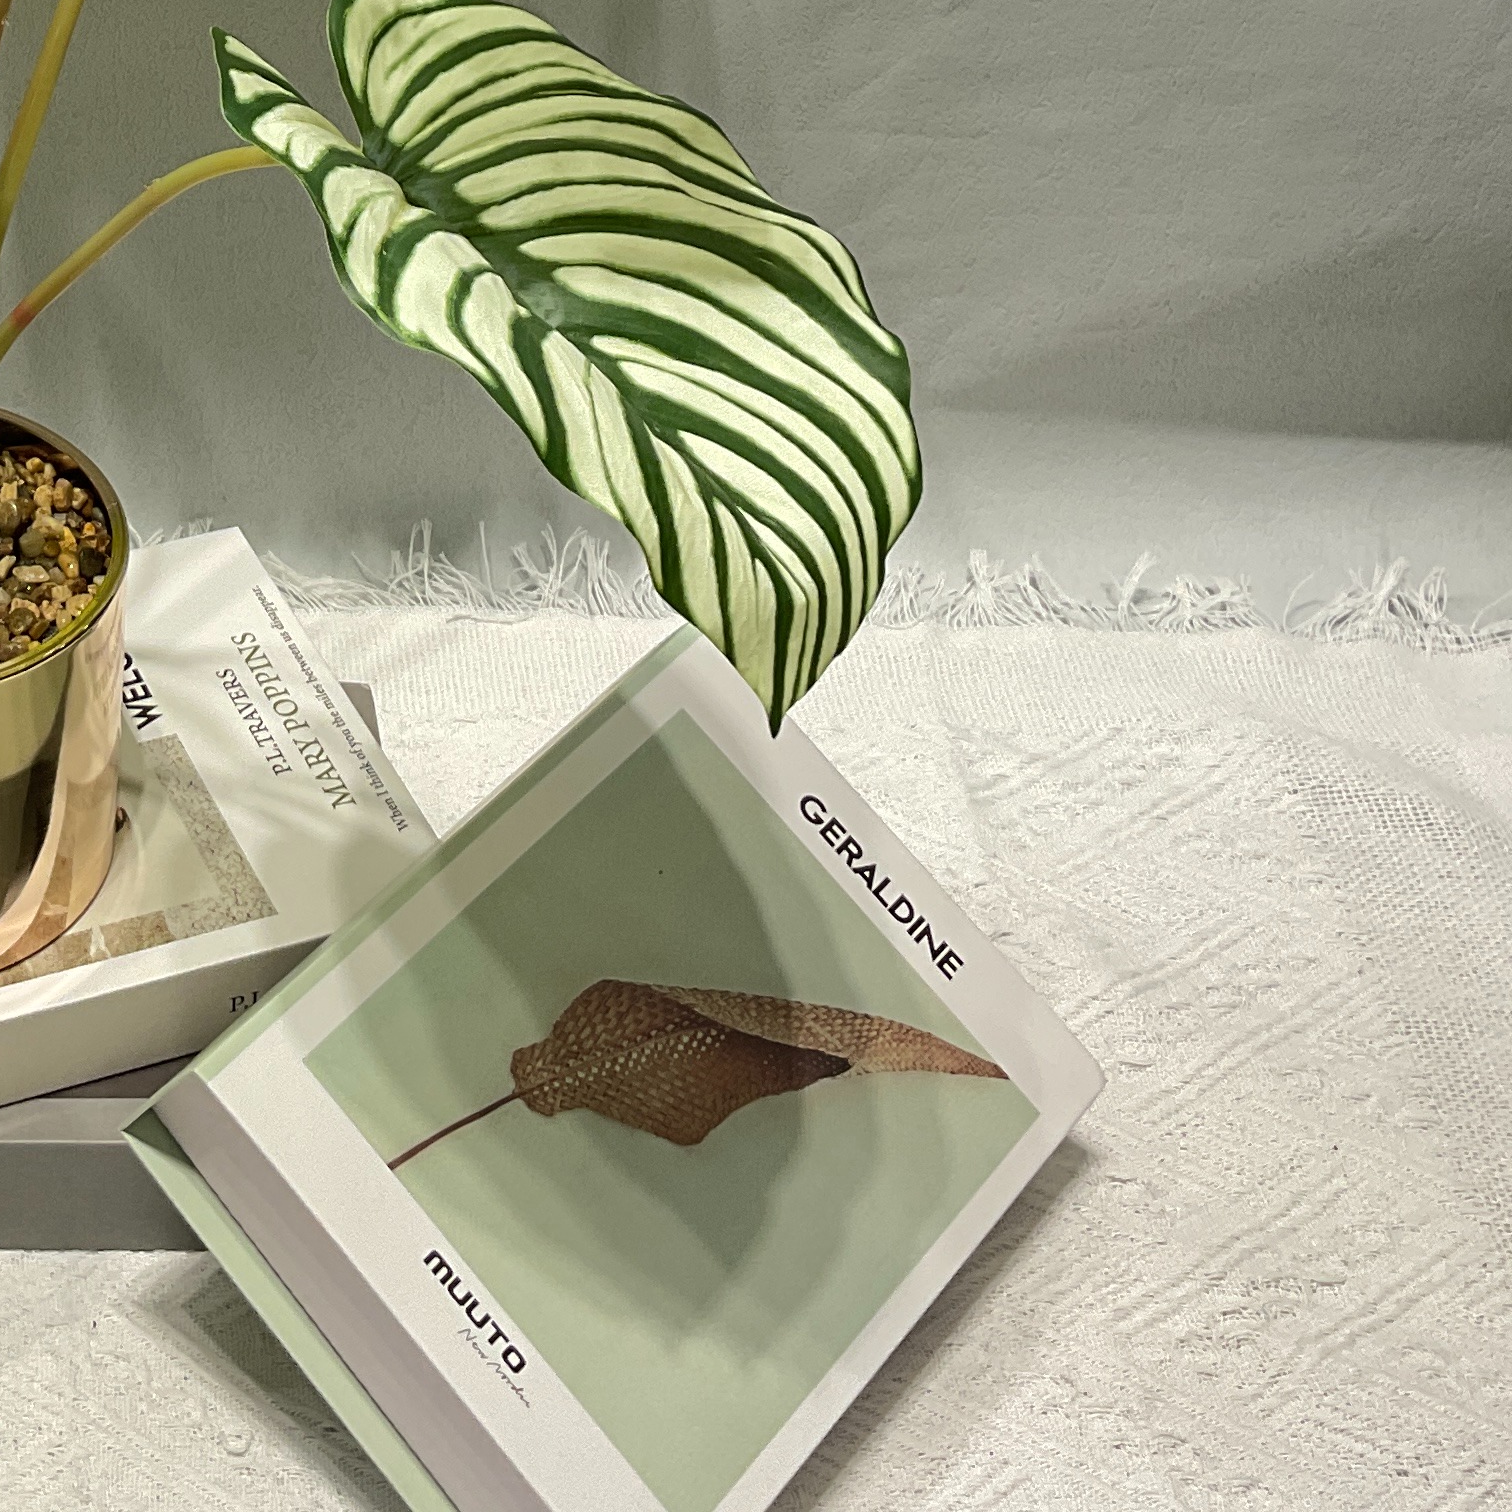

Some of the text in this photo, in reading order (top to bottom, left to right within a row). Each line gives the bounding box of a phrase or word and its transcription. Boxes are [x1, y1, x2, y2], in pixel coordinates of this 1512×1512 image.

[231, 632, 356, 809] MARY POPPINS
[252, 584, 408, 832] When I think of you the miles between us disappear.
[800, 795, 964, 981] GERALDINE
